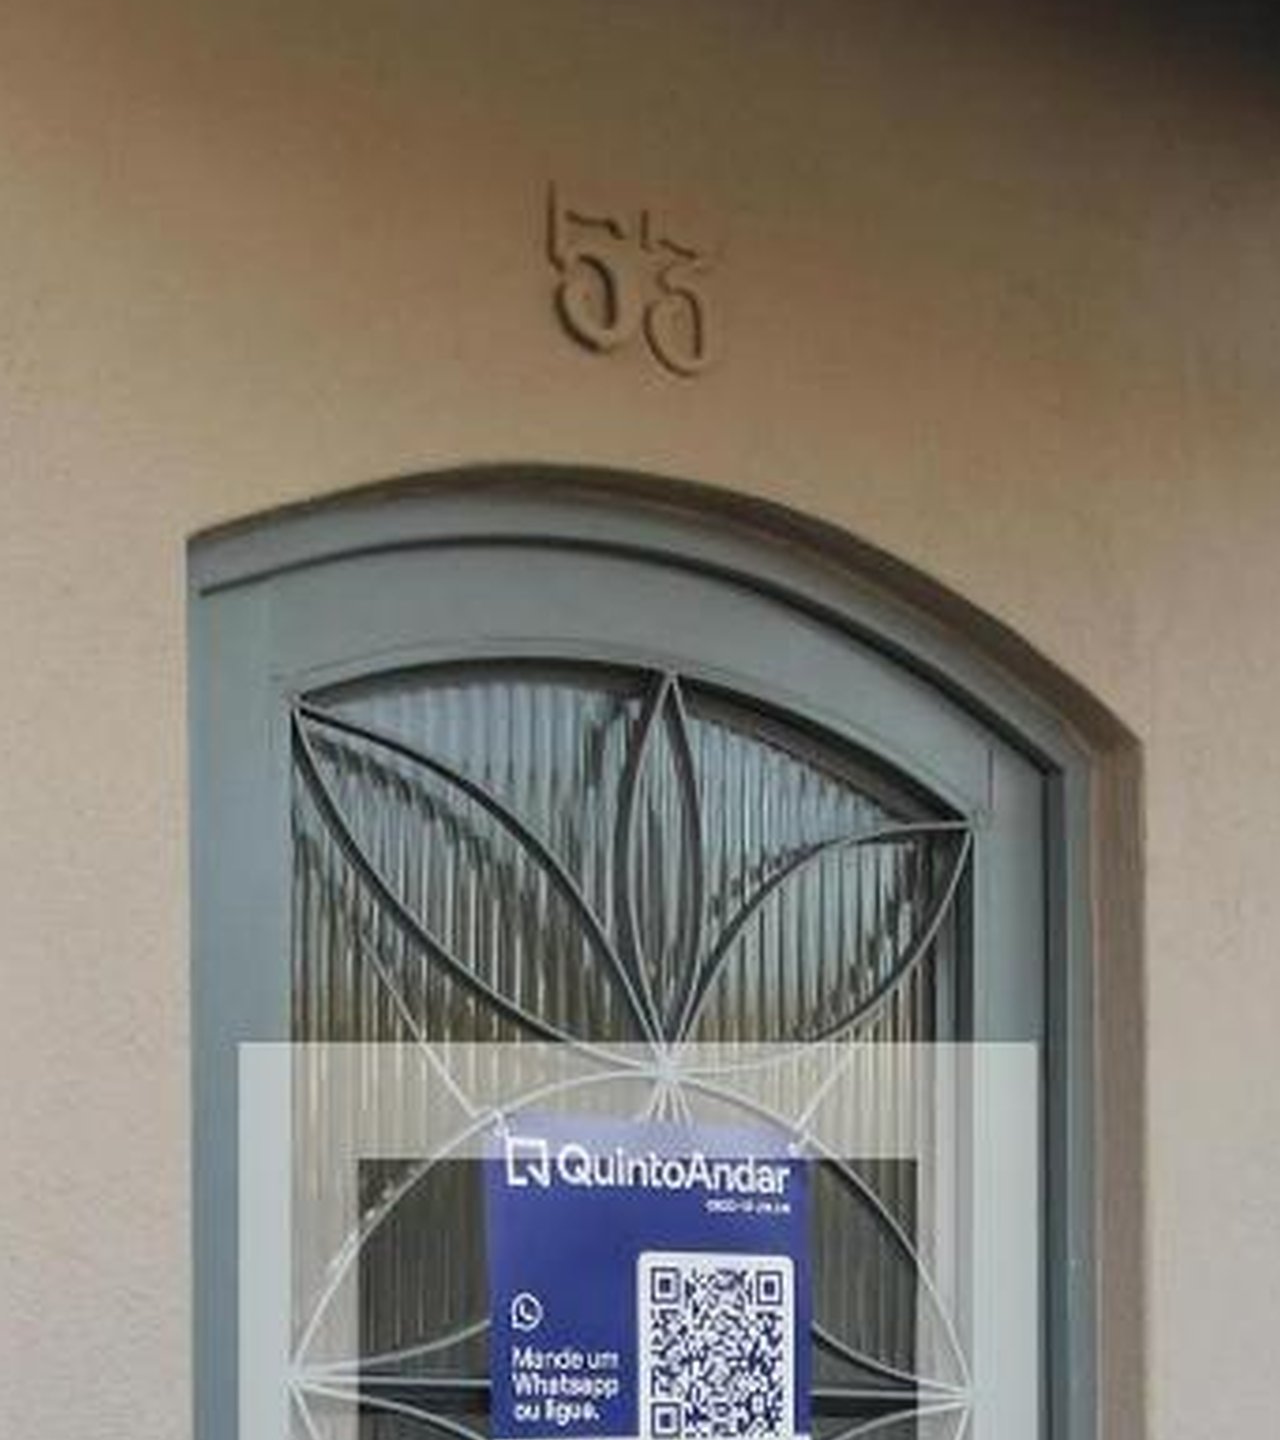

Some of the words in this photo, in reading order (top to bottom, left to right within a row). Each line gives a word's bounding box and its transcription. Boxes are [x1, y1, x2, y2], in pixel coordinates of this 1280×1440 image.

[545, 178, 718, 380] 53
[557, 1142, 791, 1194] QuintoAndar
[511, 1345, 584, 1370] Mande
[587, 1351, 619, 1370] um
[511, 1371, 619, 1399] Whatsapp
[514, 1403, 540, 1421] ou
